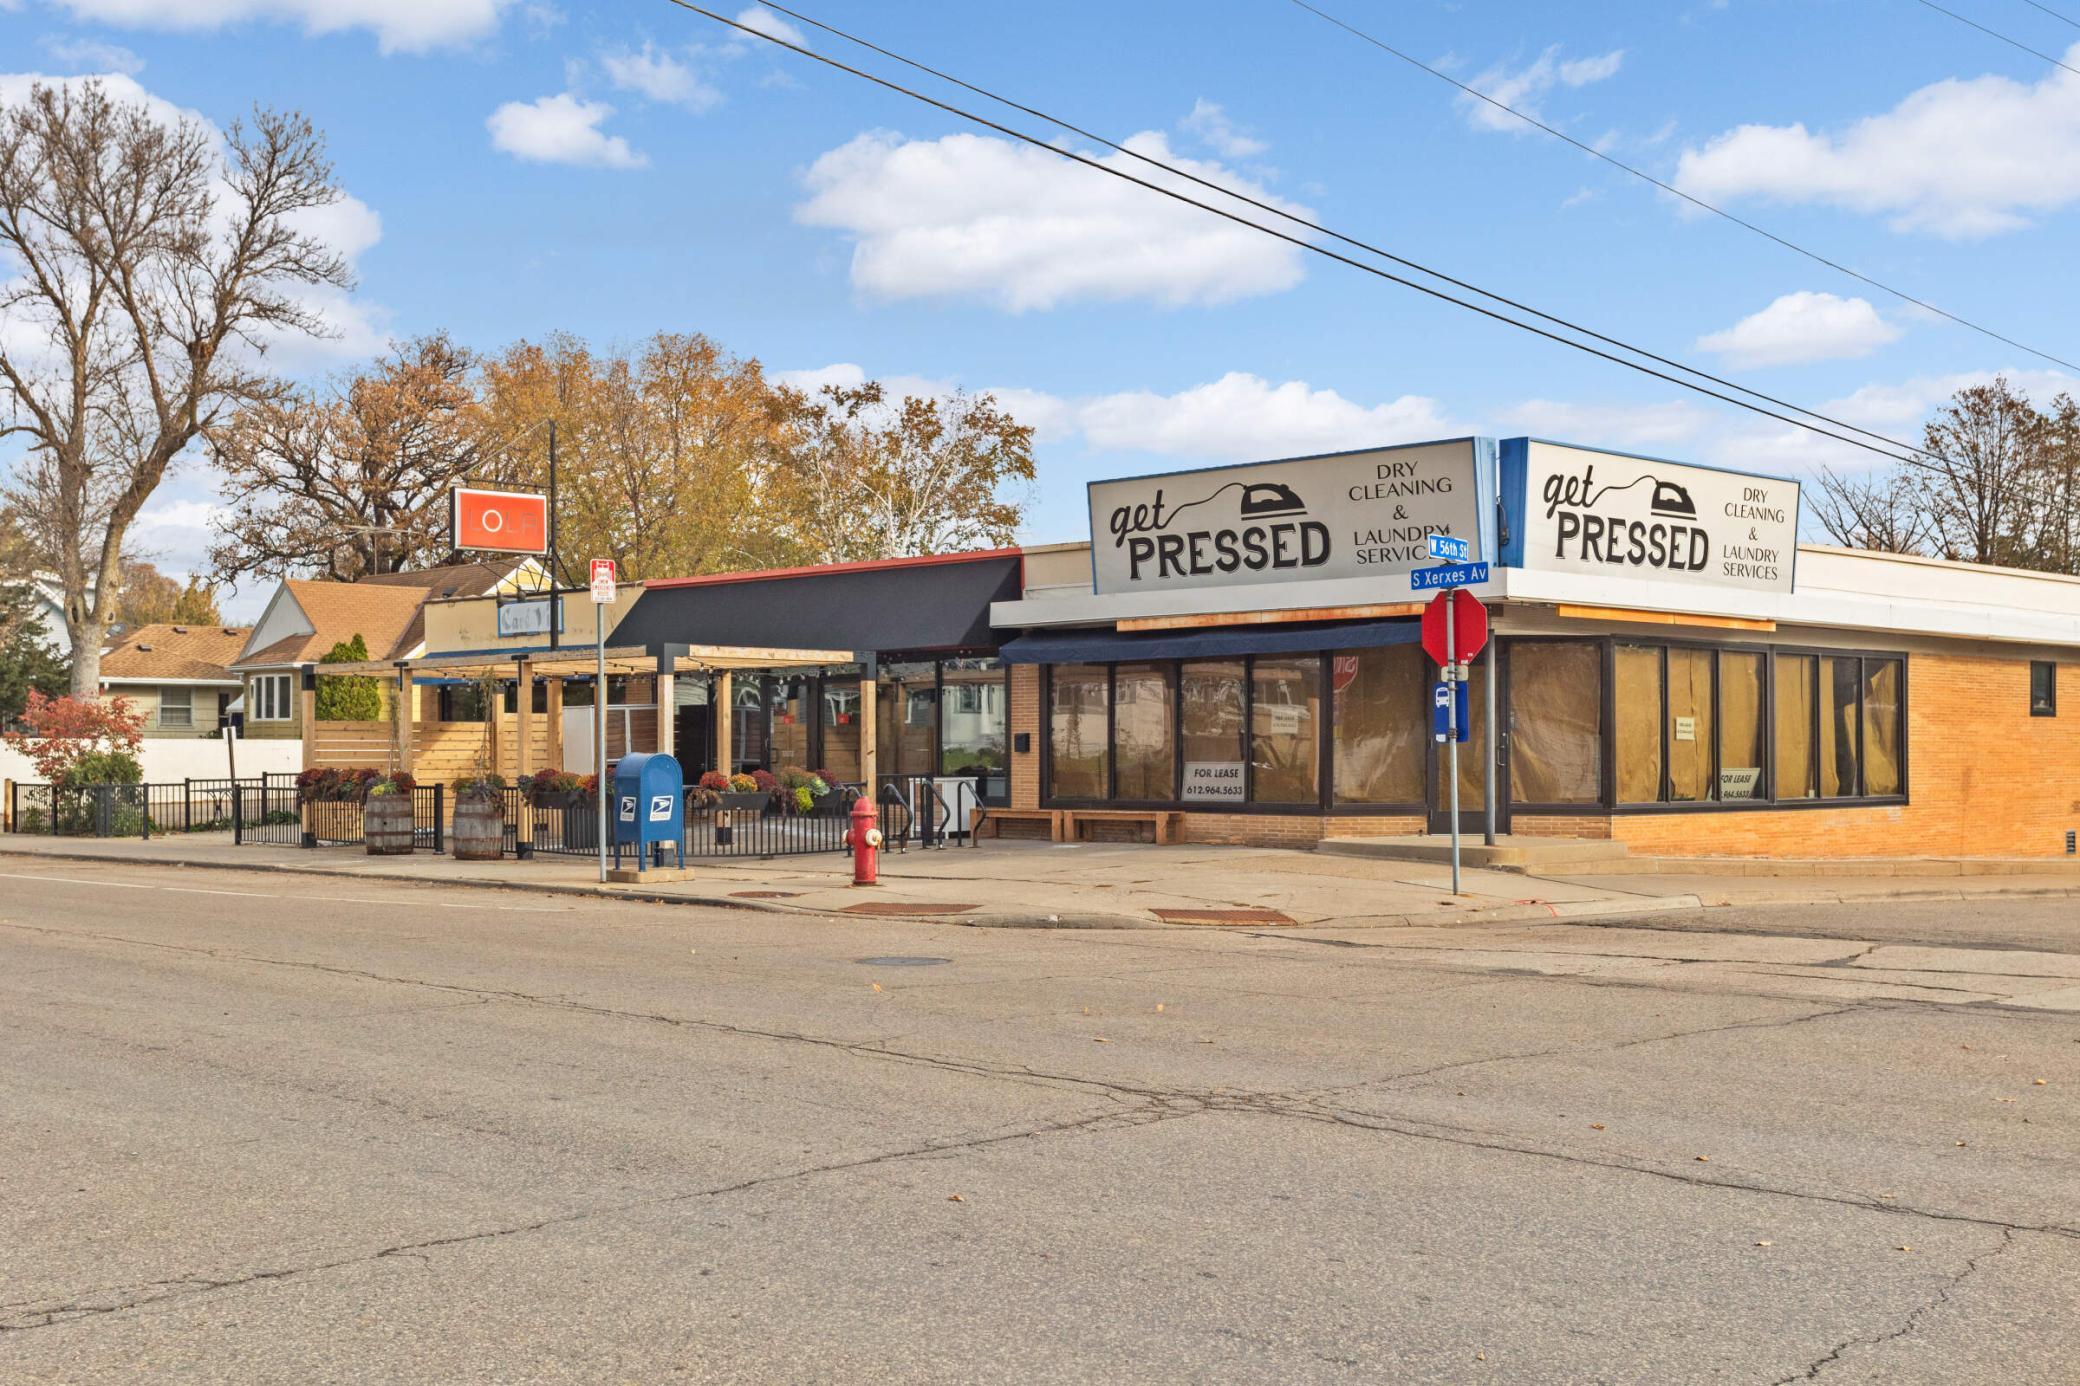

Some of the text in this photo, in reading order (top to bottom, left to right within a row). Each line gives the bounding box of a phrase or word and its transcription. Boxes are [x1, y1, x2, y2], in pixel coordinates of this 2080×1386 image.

[1377, 460, 1418, 480] DRY
[1349, 477, 1453, 501] CLEANING
[1543, 464, 1594, 520] get
[1743, 487, 1769, 504] DRY
[1110, 489, 1167, 548] get
[1392, 504, 1409, 521] &
[1724, 502, 1785, 524] CLEANING
[1555, 511, 1709, 573] PRESSED
[1748, 527, 1758, 541] &
[1128, 521, 1332, 581] PRESSED
[1356, 545, 1427, 565] SERVIC
[1430, 539, 1467, 558] W 56th St
[1723, 544, 1779, 563] LAUNDRY
[1413, 566, 1487, 587] S Xerxes Av
[1723, 561, 1778, 581] SERVICES
[1194, 768, 1239, 778] FOR LEASE
[1733, 774, 1752, 784] LEASE
[1187, 785, 1243, 796] 612.964.5633
